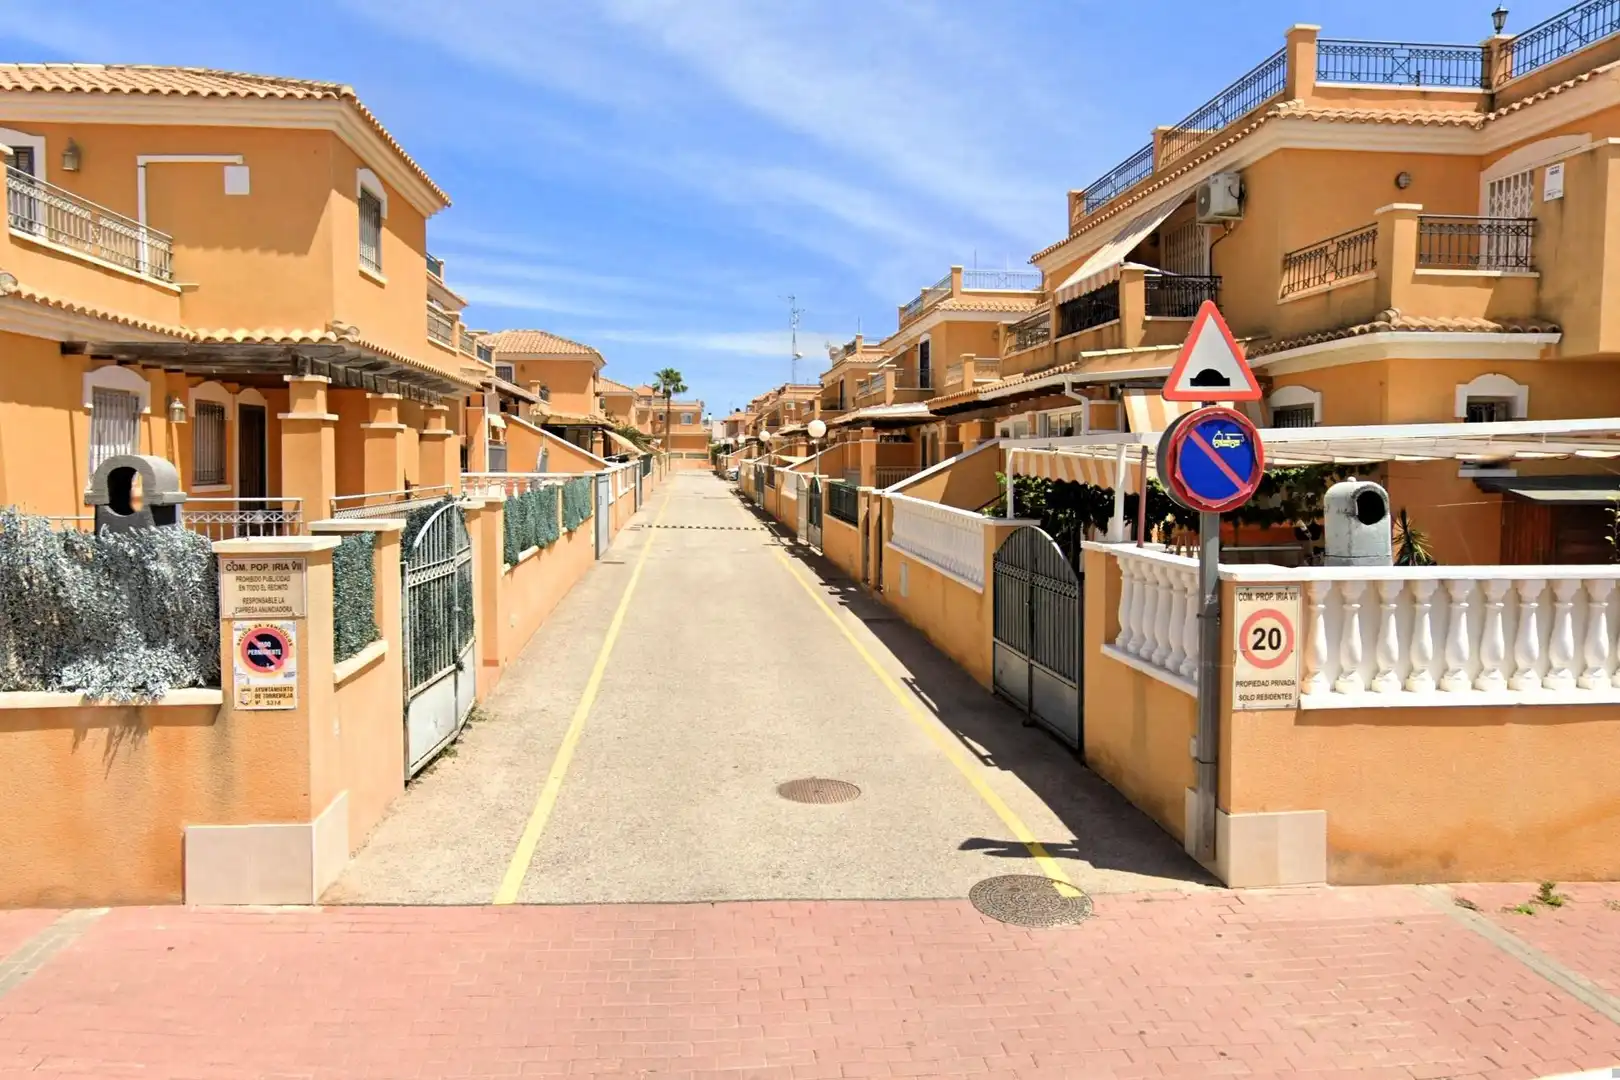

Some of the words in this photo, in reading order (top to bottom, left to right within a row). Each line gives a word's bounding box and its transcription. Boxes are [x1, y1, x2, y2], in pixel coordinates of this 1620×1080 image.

[272, 563, 290, 571] IRIA
[1276, 592, 1288, 600] IRIA
[1252, 627, 1282, 651] 20
[1256, 692, 1292, 700] RESIDENTES
